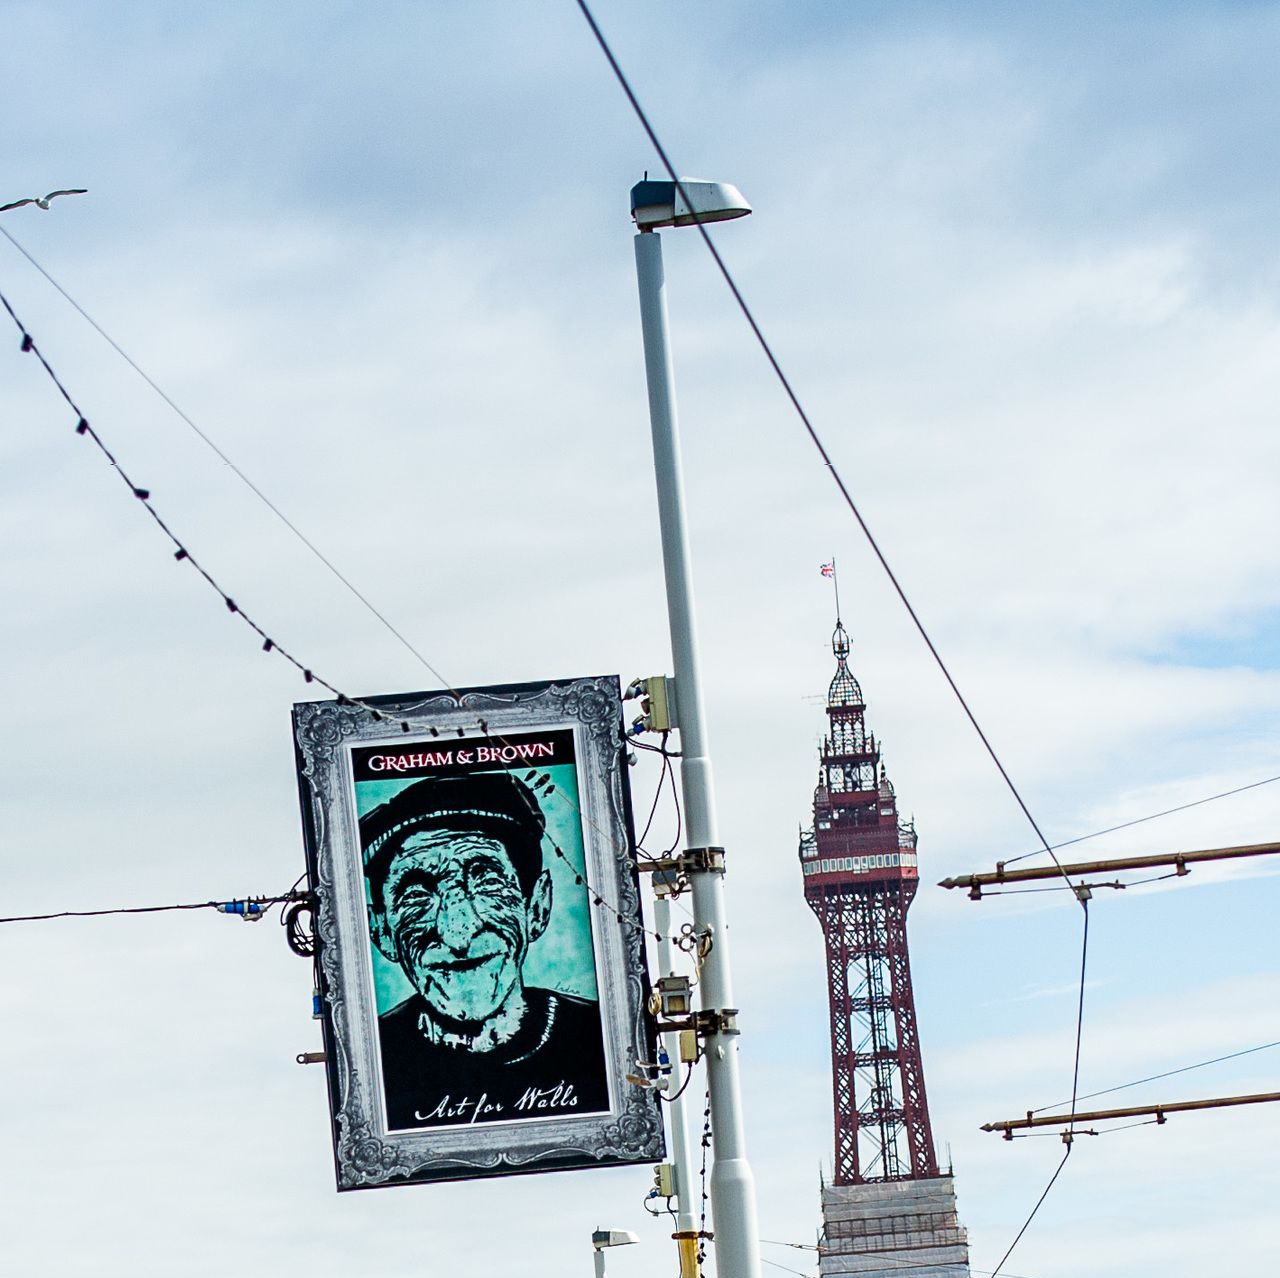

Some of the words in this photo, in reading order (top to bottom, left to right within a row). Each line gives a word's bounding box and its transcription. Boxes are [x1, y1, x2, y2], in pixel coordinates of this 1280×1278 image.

[368, 751, 453, 772] GRAHAM
[456, 750, 474, 764] &
[476, 742, 555, 764] BROWN
[414, 1095, 475, 1121] Art
[470, 1092, 504, 1124] for
[514, 1080, 578, 1111] Walls
